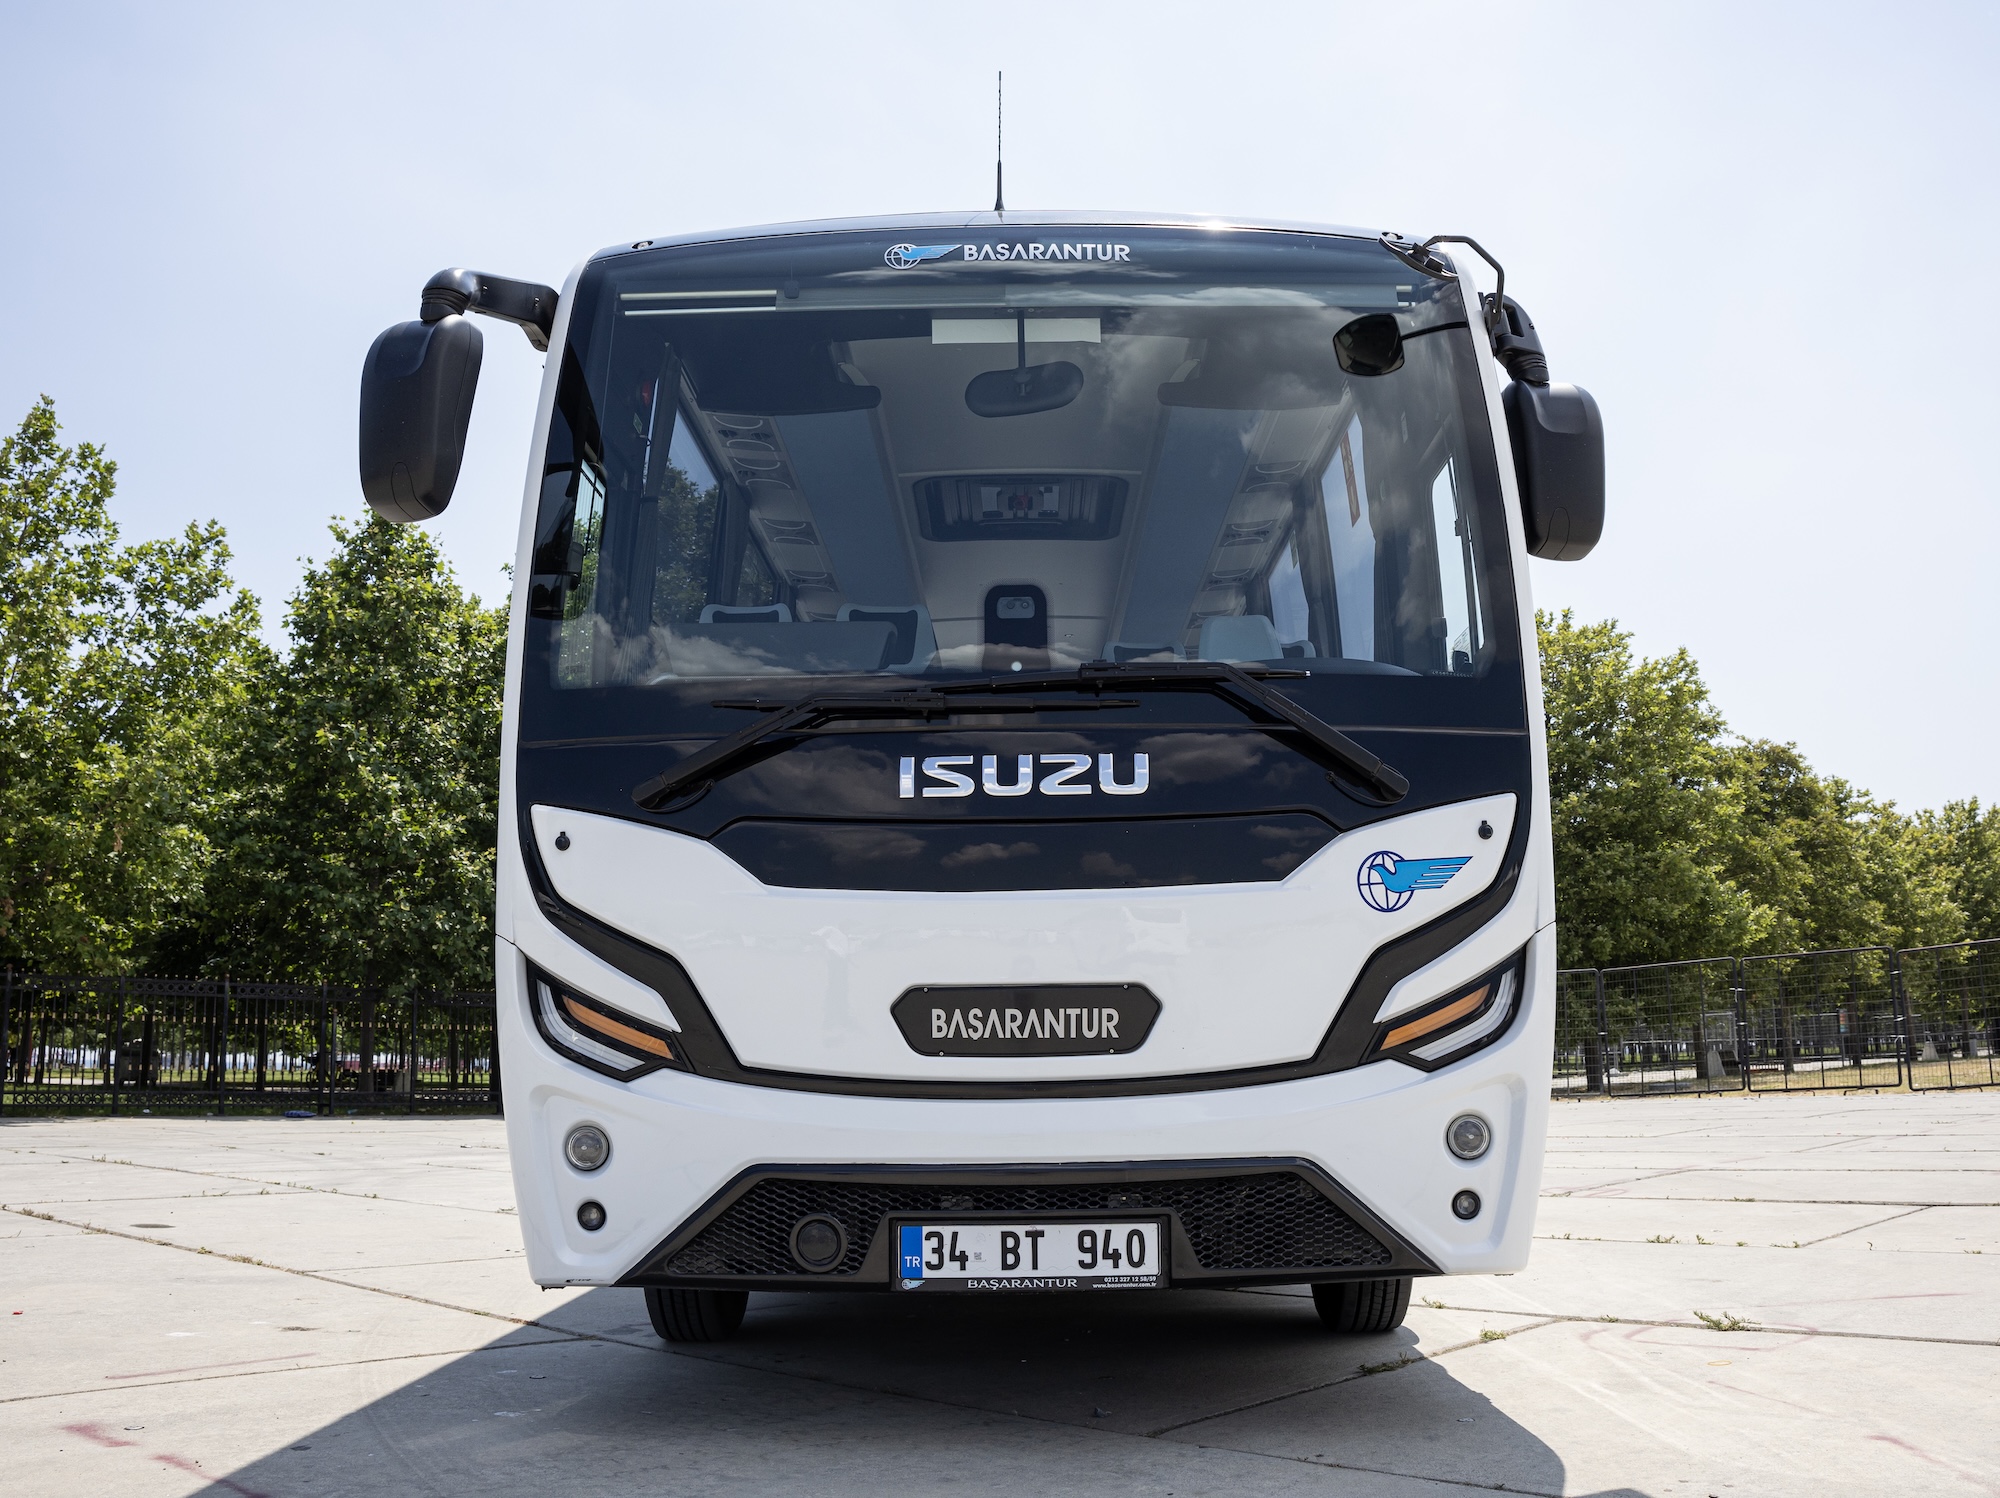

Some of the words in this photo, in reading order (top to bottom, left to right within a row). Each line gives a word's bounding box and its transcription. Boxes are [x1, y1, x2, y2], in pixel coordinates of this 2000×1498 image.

[899, 753, 1149, 798] ISUZU
[904, 1256, 921, 1268] TR
[924, 1231, 969, 1271] 34
[1000, 1229, 1045, 1271] BT
[1077, 1229, 1146, 1270] 940
[967, 1278, 1078, 1291] BAŞARANTUR
